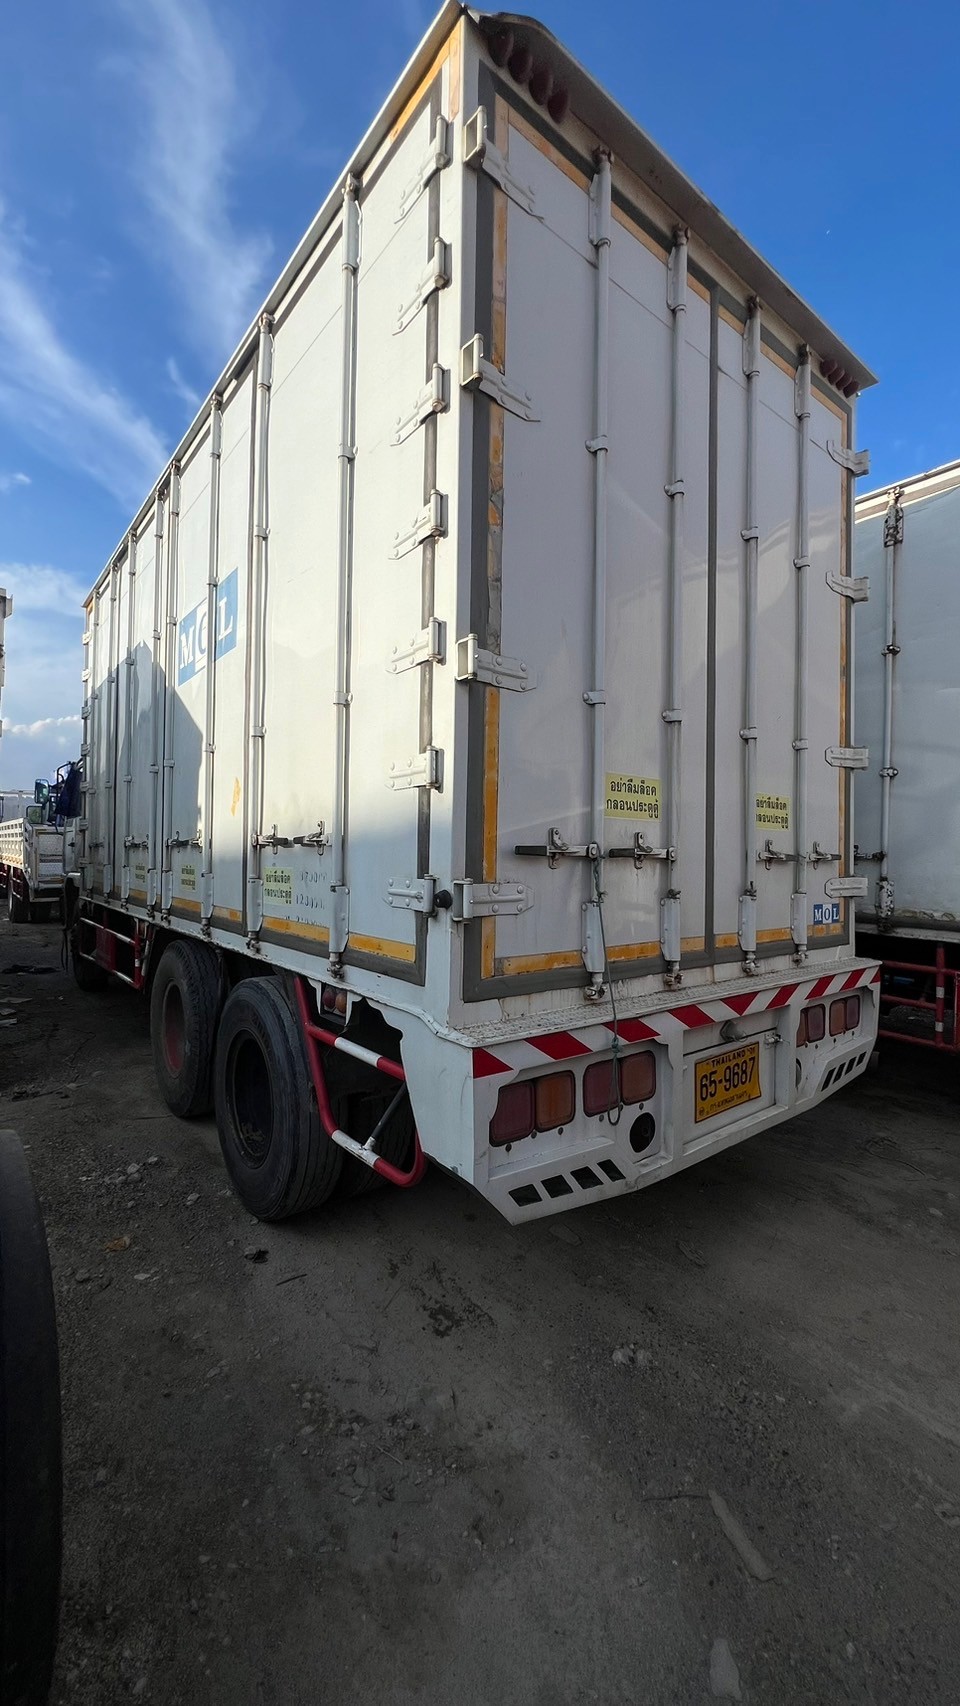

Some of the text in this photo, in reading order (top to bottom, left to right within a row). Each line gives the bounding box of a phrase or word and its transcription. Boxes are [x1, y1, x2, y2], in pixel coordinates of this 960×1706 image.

[814, 906, 840, 922] MOL
[711, 1049, 746, 1067] THAILAND
[700, 1056, 756, 1101] 65-9687
